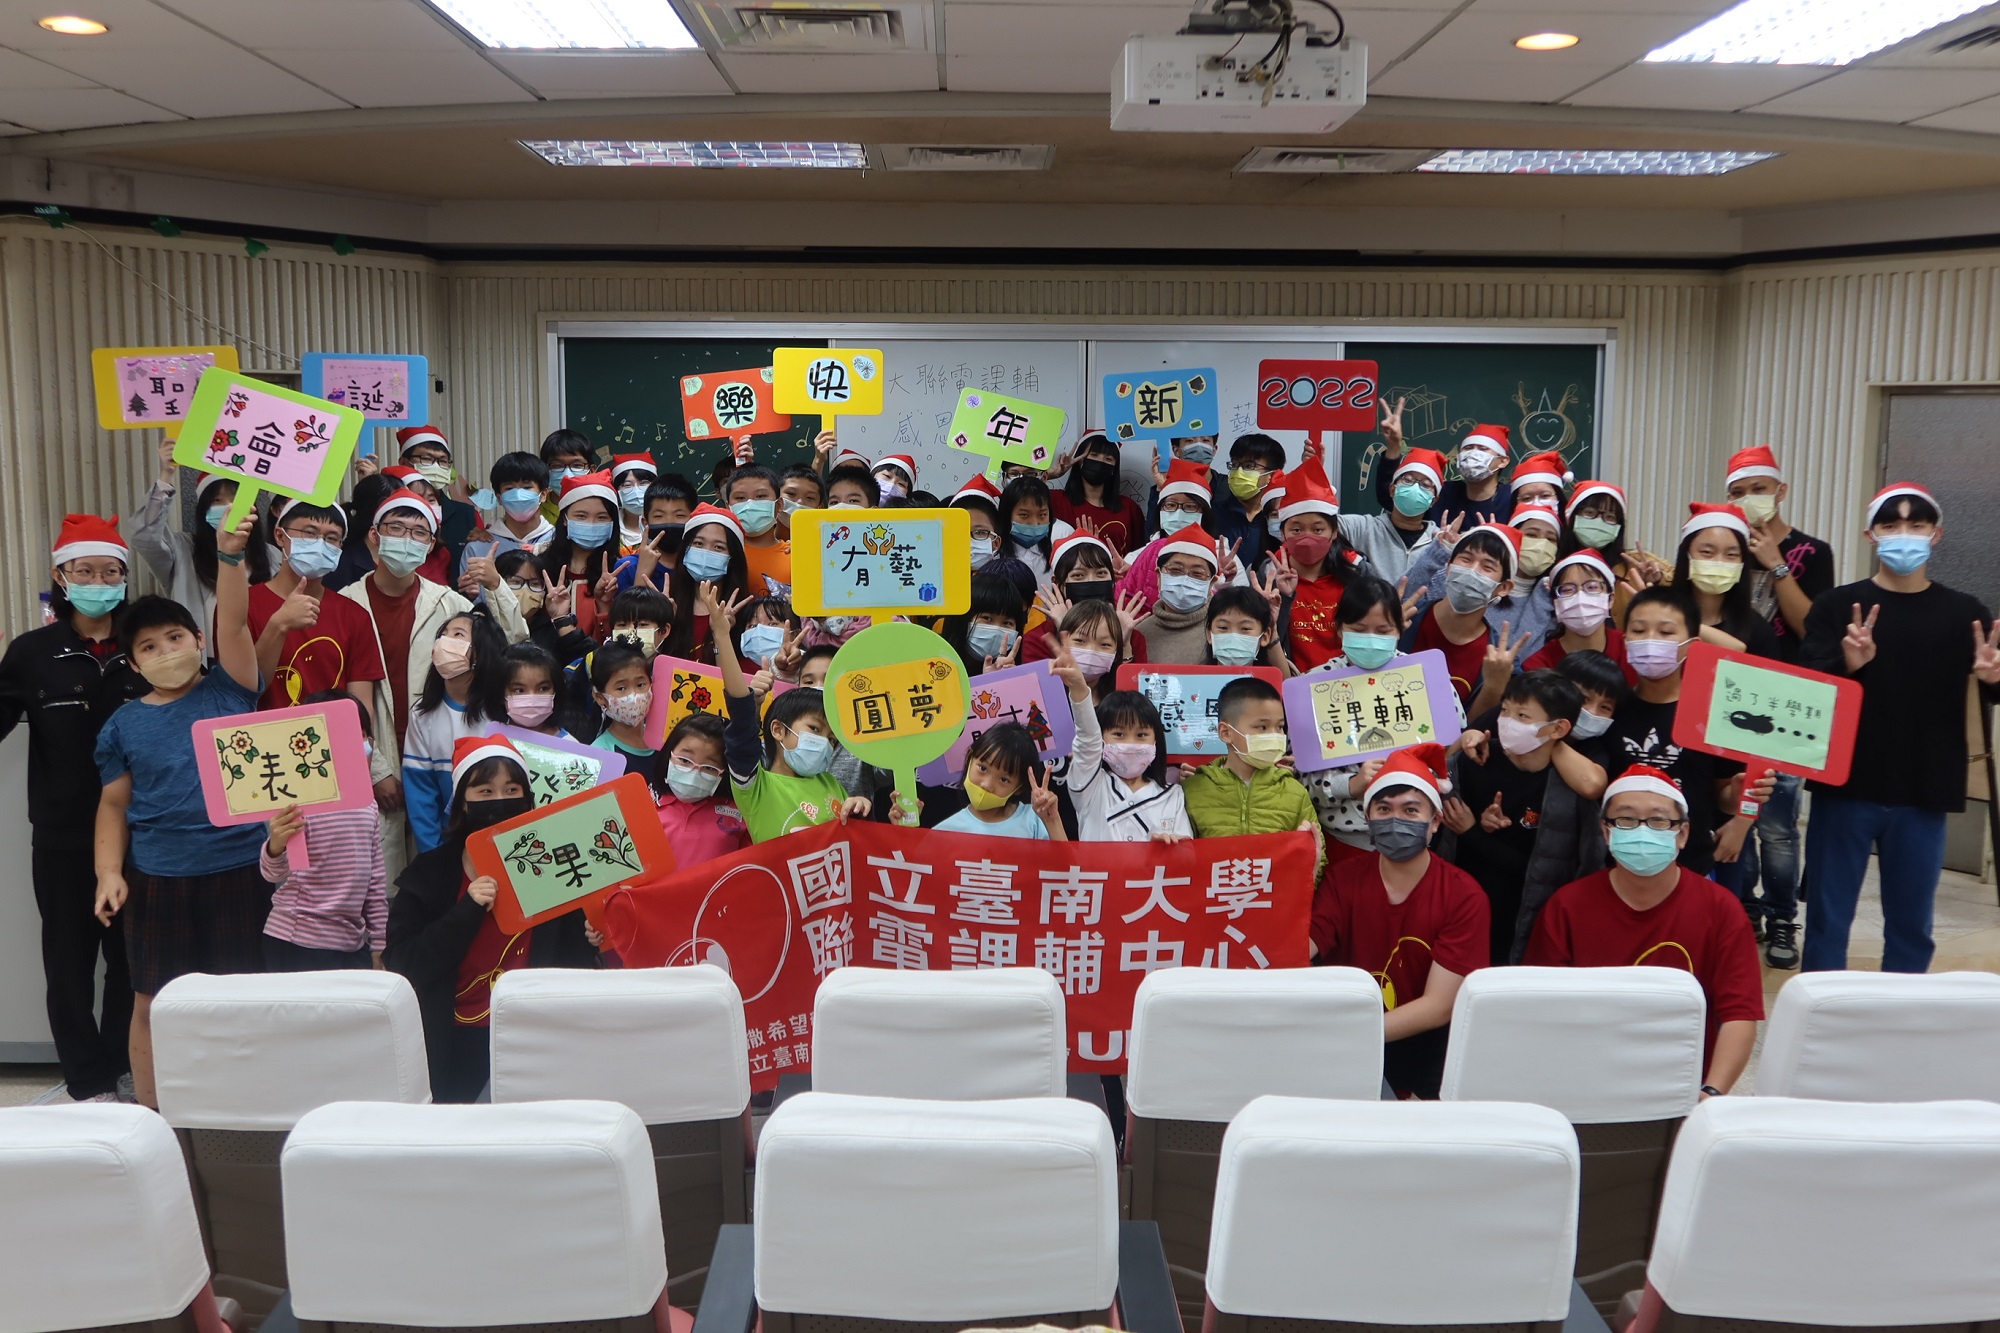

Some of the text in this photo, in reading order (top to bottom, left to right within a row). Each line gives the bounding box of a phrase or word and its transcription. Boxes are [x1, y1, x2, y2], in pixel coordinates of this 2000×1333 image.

[149, 376, 185, 416] 聖
[347, 380, 385, 411] 誕
[809, 360, 849, 400] 快
[888, 362, 1040, 395] 大聯電課輔
[1260, 376, 1376, 409] 2022
[716, 385, 754, 425] 樂
[1138, 384, 1179, 426] 新
[892, 412, 952, 447] 感恩
[986, 406, 1029, 446] 年
[248, 421, 286, 475] 會
[851, 684, 944, 734] 圓夢
[1327, 690, 1415, 736] 課輔
[260, 752, 297, 801] 表
[554, 842, 592, 888] 果
[786, 841, 1274, 926] 國立臺南大學
[802, 911, 1271, 996] 聯電課輔中心
[747, 1012, 814, 1050] 撒希望
[1078, 1029, 1132, 1062] U
[750, 1042, 810, 1074] 立臺南
